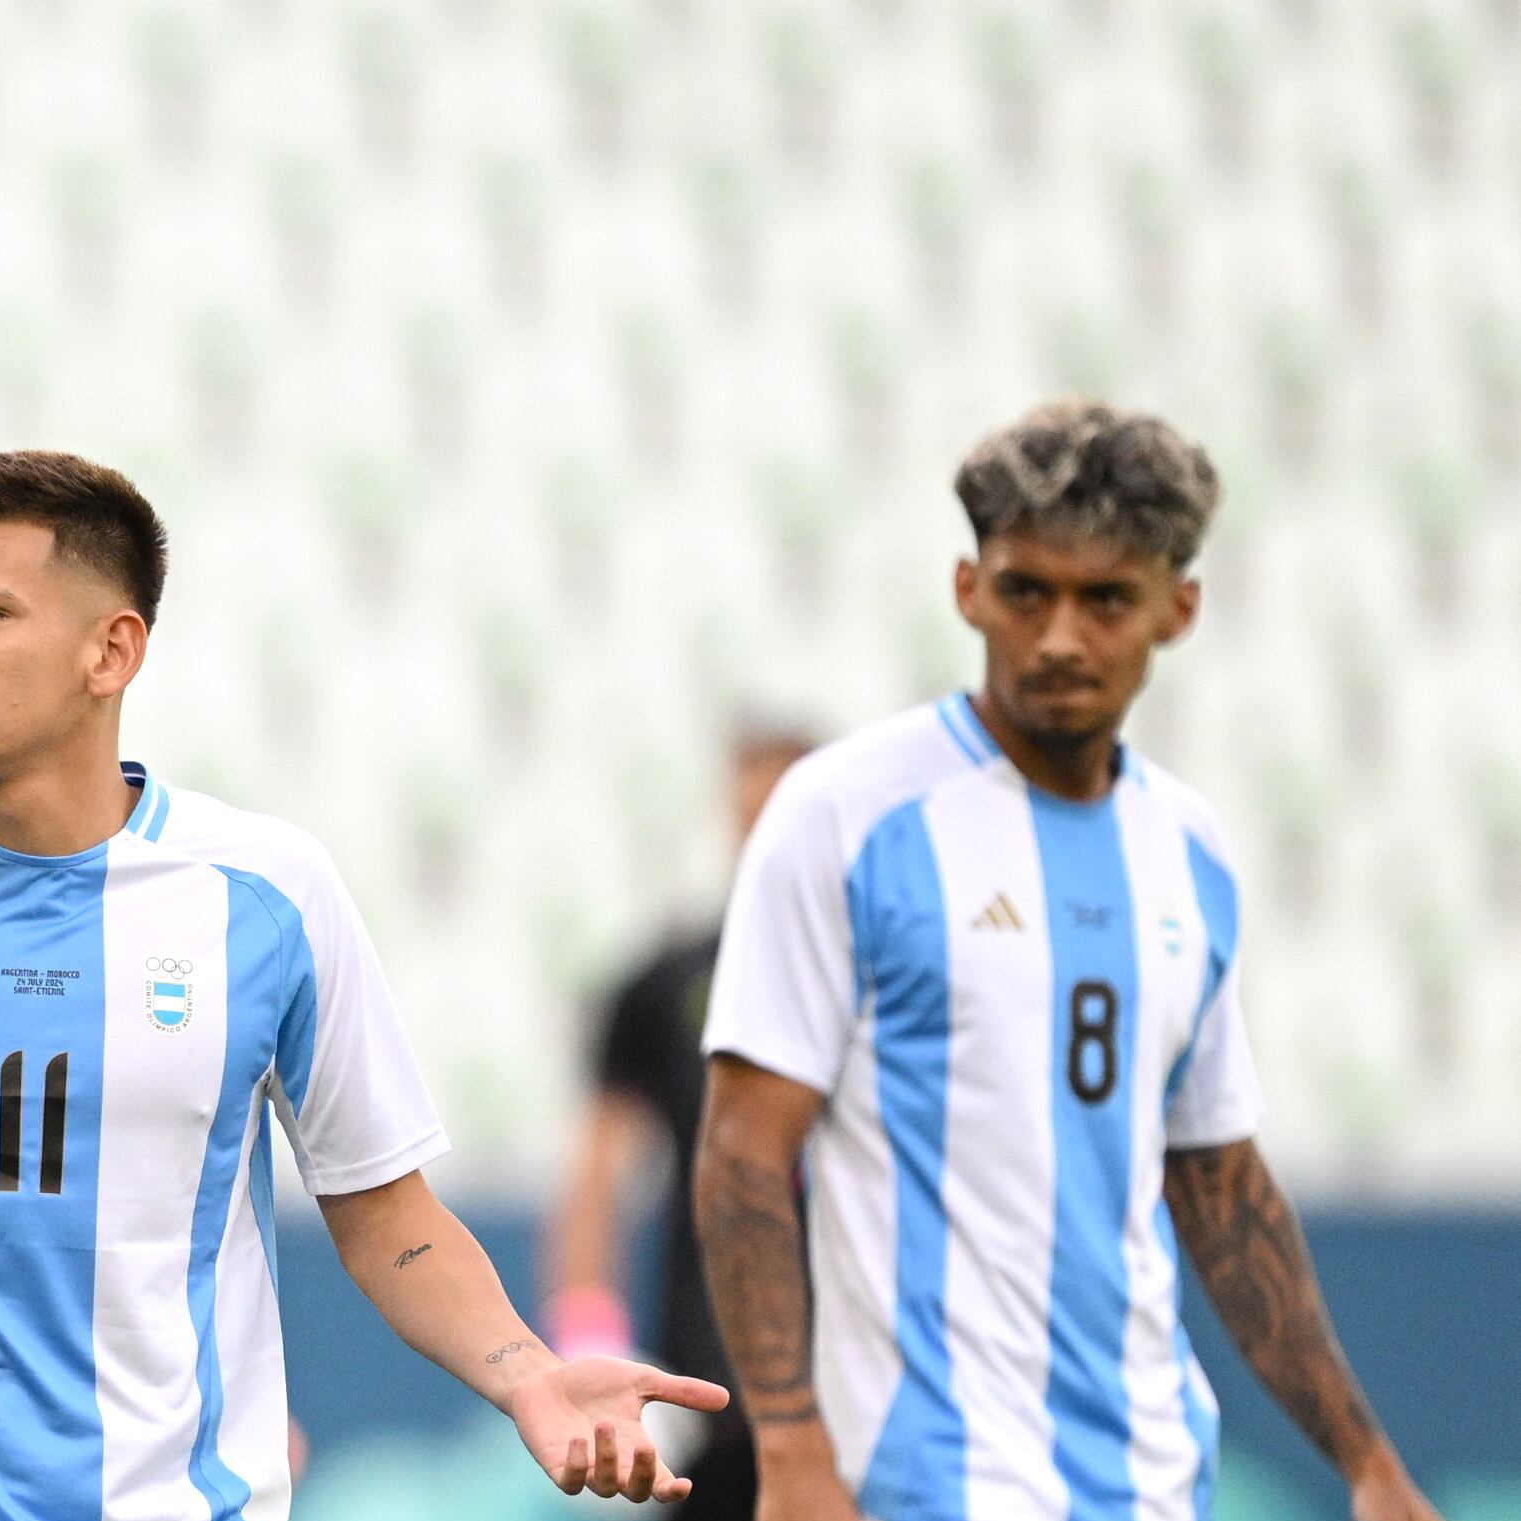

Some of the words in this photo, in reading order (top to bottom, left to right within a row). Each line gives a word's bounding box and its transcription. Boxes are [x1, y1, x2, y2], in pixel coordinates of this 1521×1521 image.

[1, 968, 38, 978] ARGENTINA
[47, 970, 80, 979] MOROCCO
[16, 977, 26, 986] 24
[28, 978, 44, 986] JULY
[45, 978, 64, 987] 2024
[14, 986, 65, 996] SAINT-ETIENNE
[1067, 979, 1119, 1106] 8
